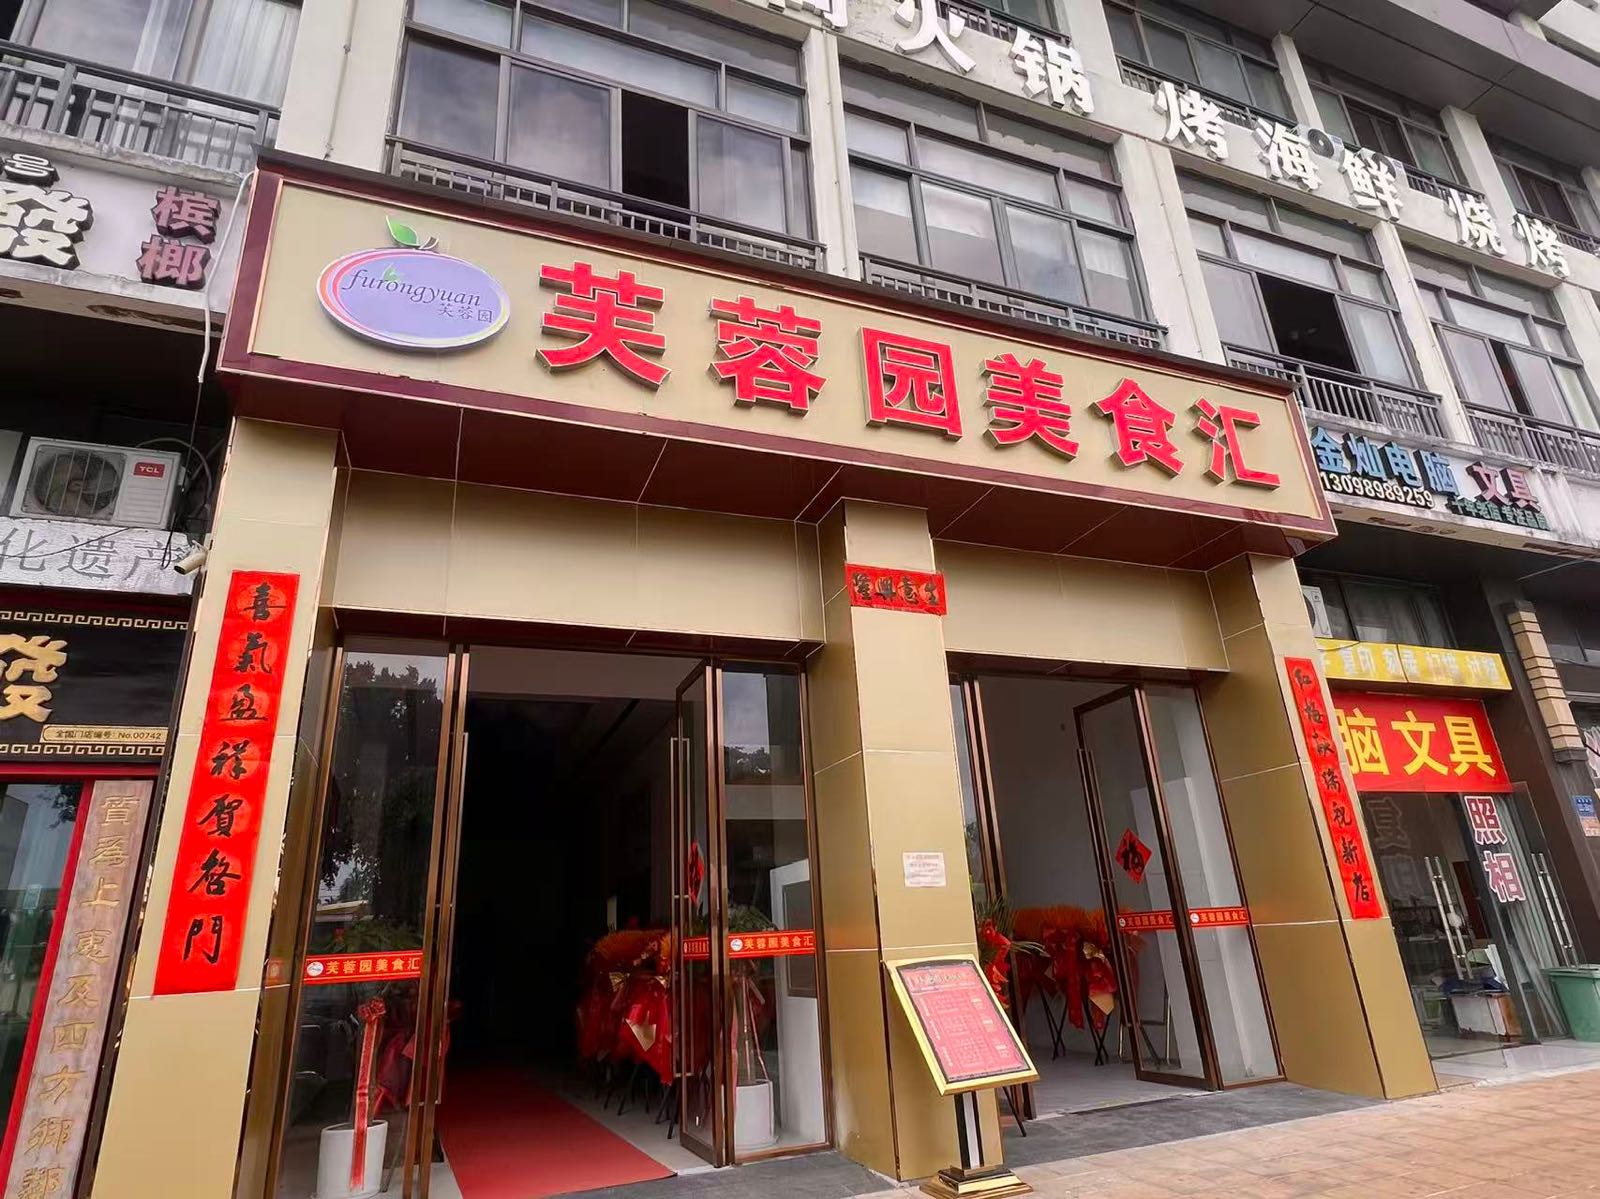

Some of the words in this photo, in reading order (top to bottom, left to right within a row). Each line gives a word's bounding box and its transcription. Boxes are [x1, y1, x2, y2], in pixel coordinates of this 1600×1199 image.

[137, 186, 221, 288] 槟榔
[342, 268, 481, 306] furongyuan
[438, 303, 493, 323] 芙蓉园
[536, 260, 1281, 489] 芙蓉园美食汇
[138, 464, 161, 475] TCL
[1311, 426, 1459, 497] 金灿电脑
[1468, 462, 1541, 509] 文具
[1320, 471, 1435, 509] 13098989259
[118, 732, 161, 740] No.00742
[1333, 707, 1497, 777] 脑文具
[1464, 796, 1526, 903] 照相
[744, 935, 814, 950] 芙蓉园美食汇
[326, 957, 420, 975] 芙蓉园美食汇
